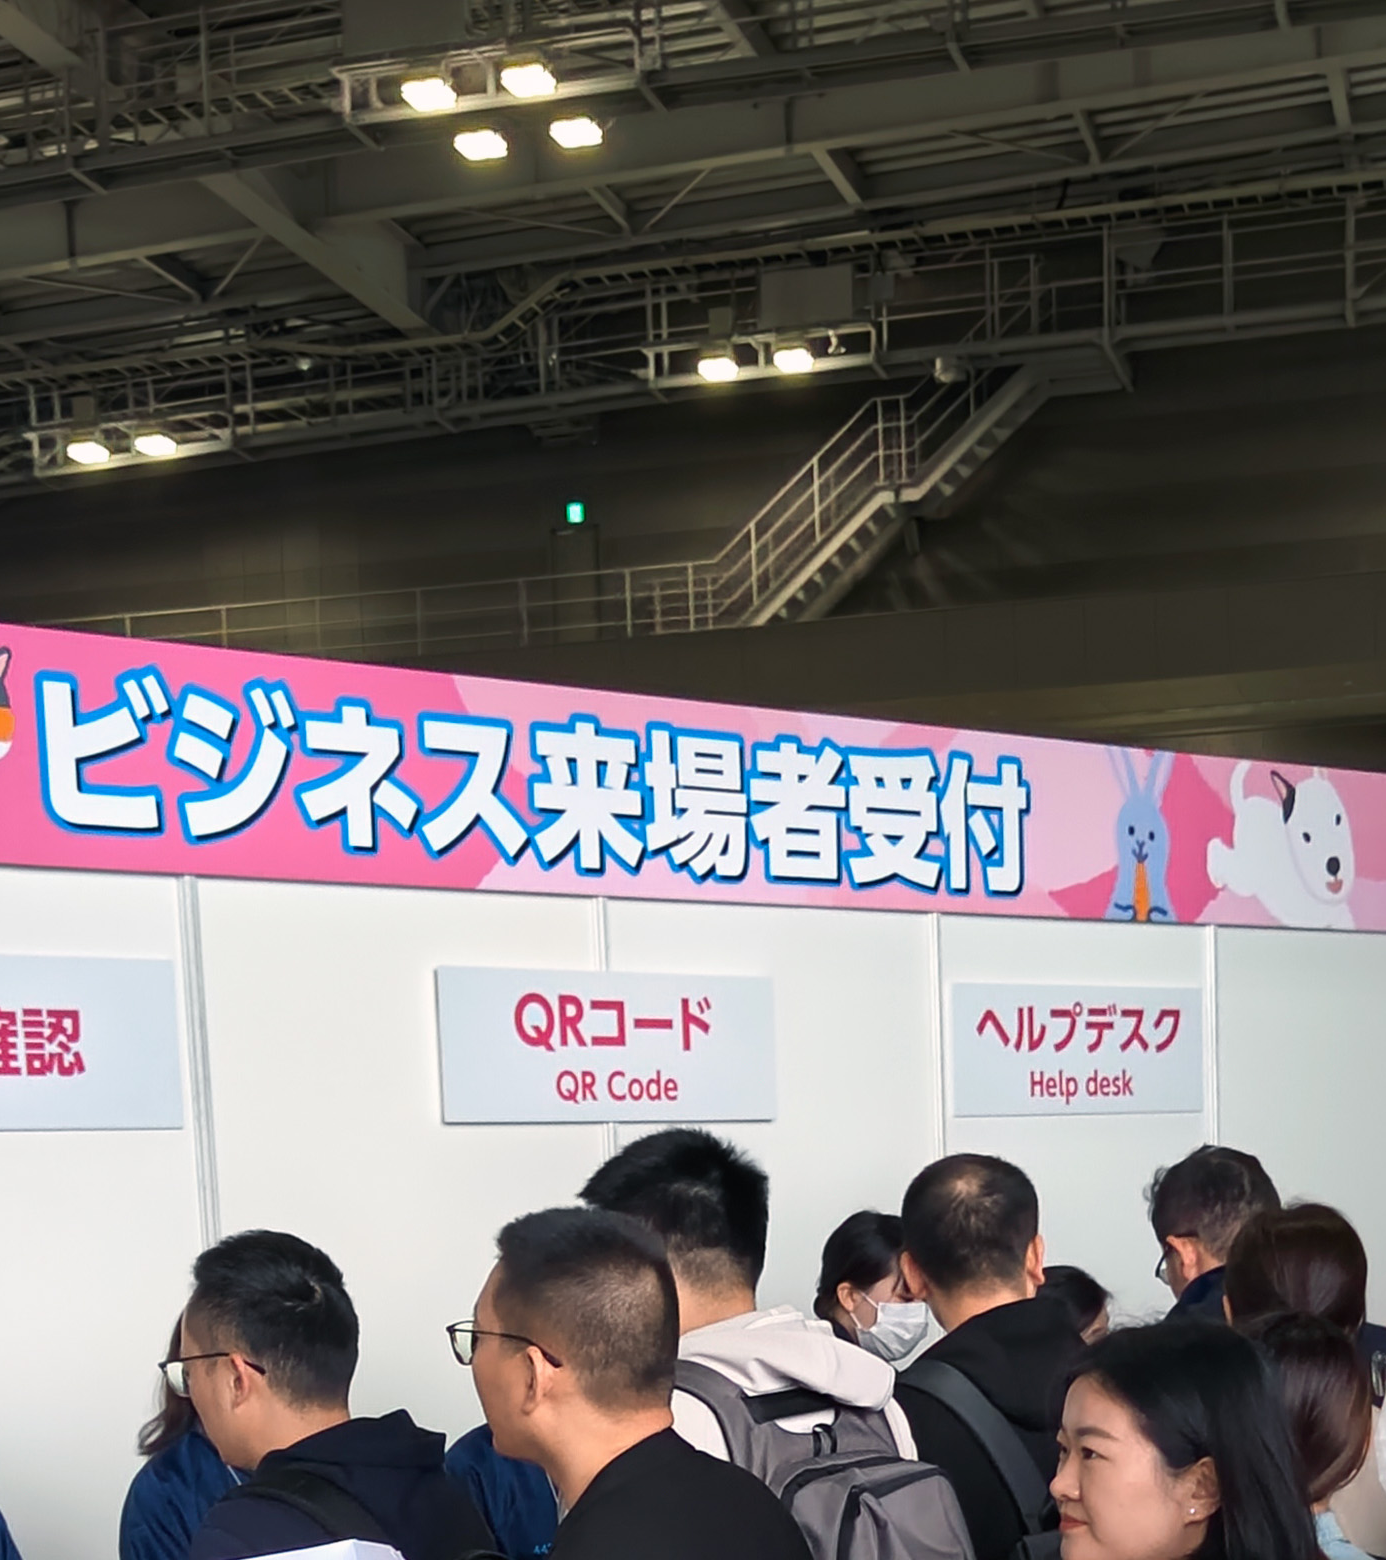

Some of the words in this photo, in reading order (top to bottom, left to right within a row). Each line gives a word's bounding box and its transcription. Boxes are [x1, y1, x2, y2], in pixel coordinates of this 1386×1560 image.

[34, 668, 1027, 896] ビジネス来場者受付
[514, 993, 712, 1051] QRコード
[976, 1002, 1181, 1053] ヘルプデスク
[556, 1071, 597, 1103] QR
[607, 1070, 679, 1101] Code
[1030, 1070, 1078, 1105] Help
[1085, 1069, 1134, 1097] desk
